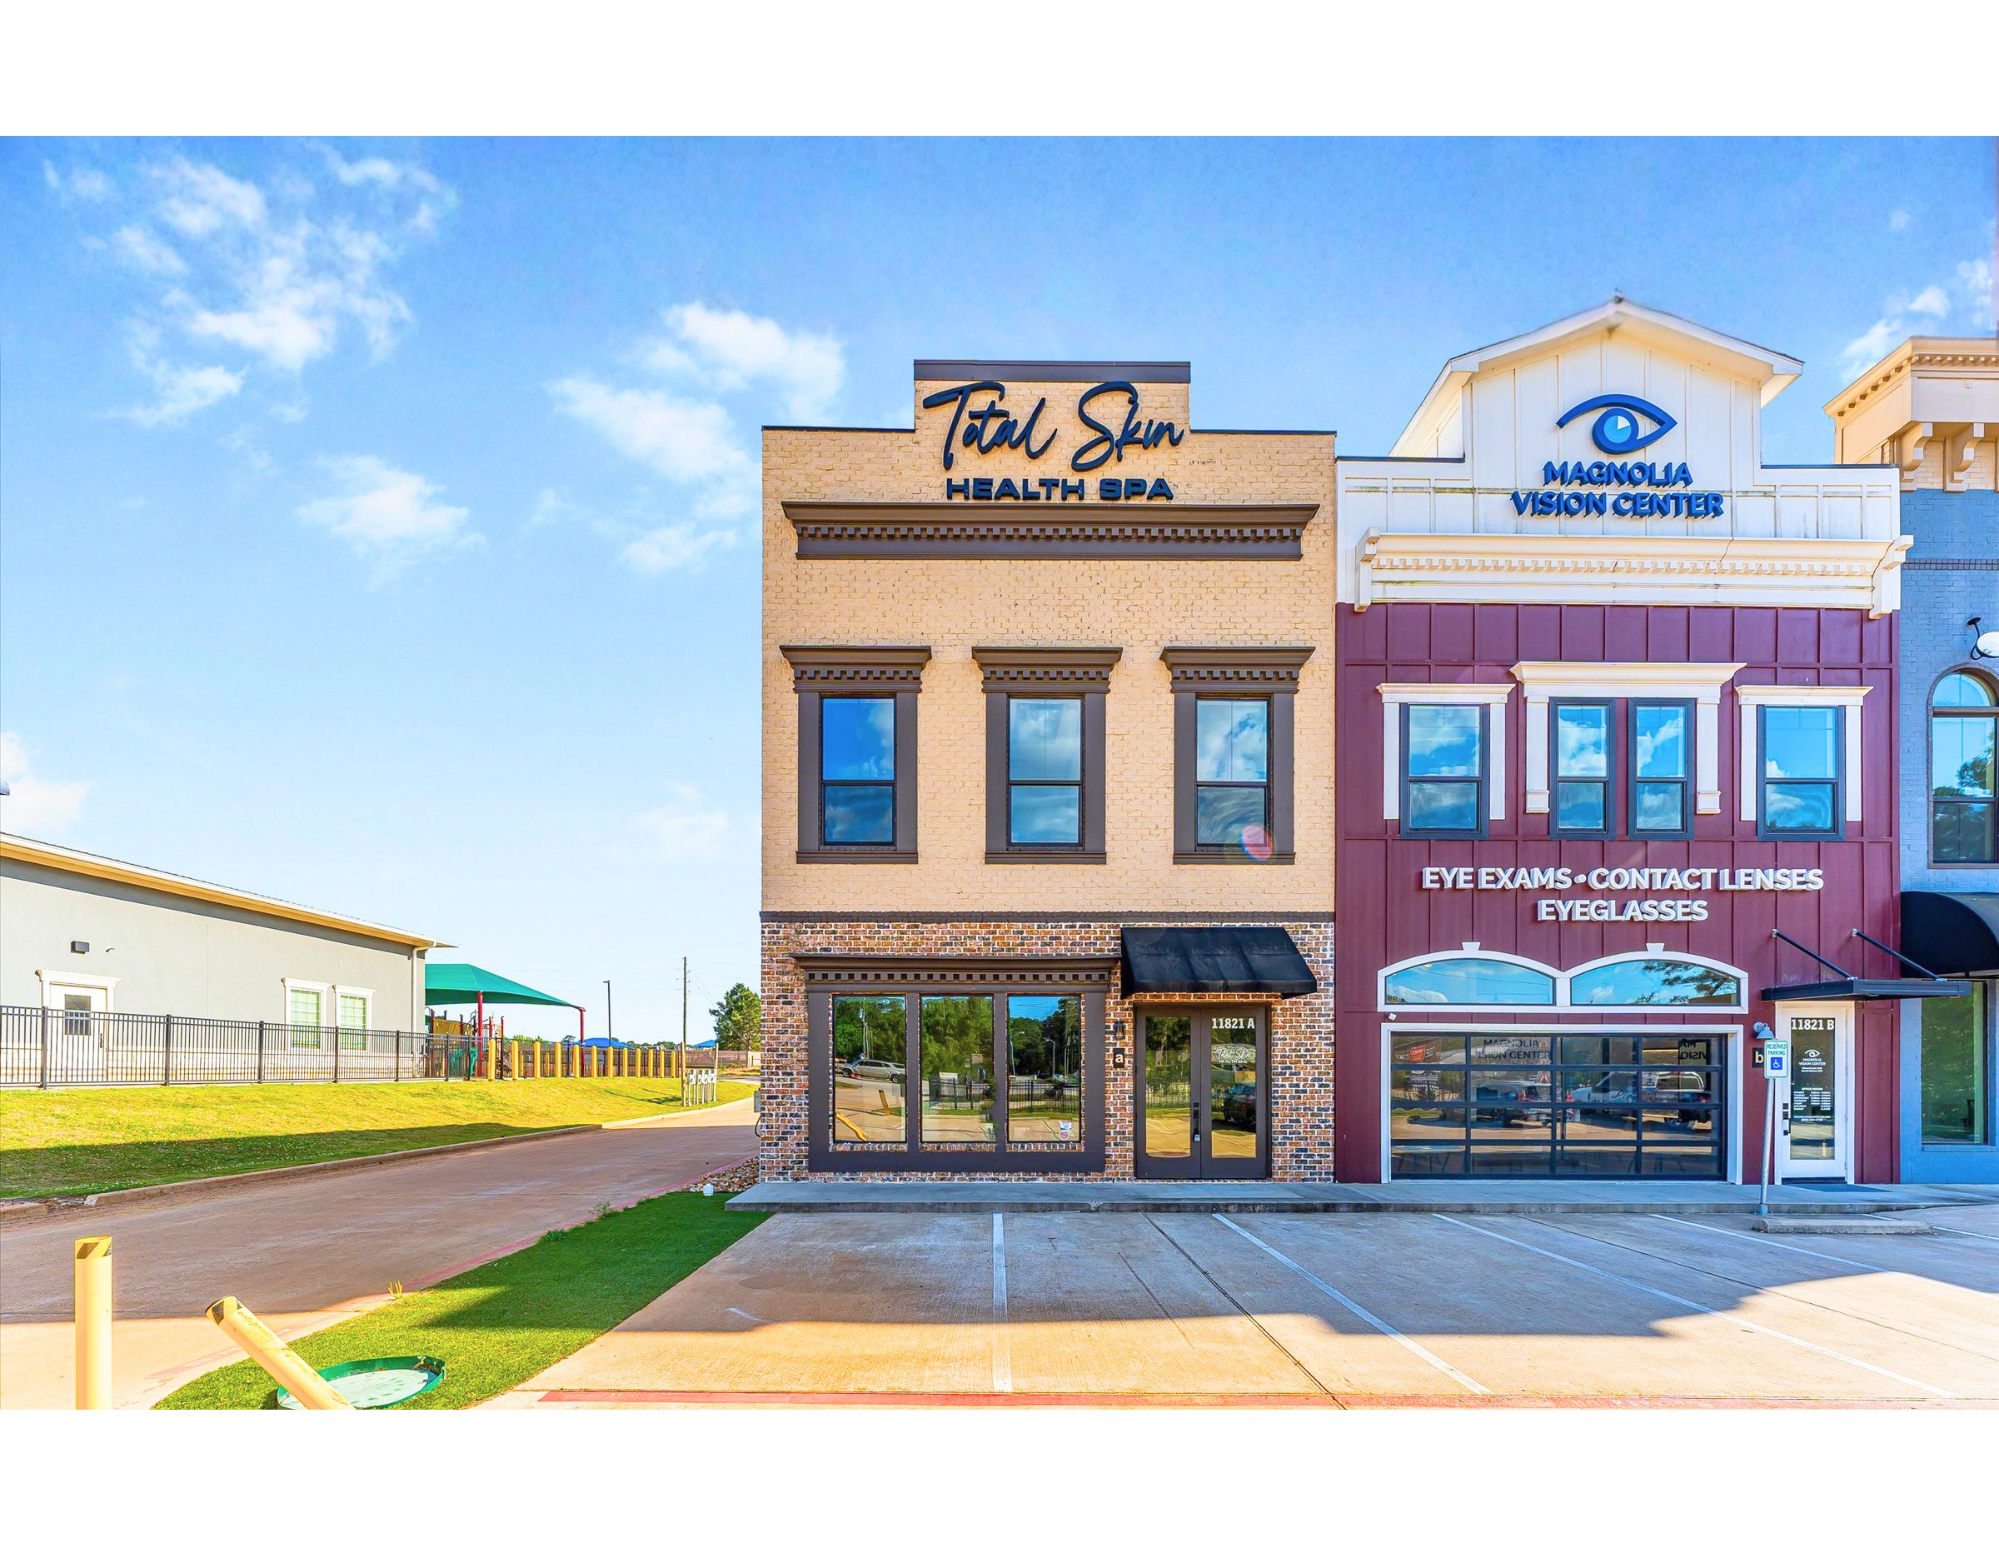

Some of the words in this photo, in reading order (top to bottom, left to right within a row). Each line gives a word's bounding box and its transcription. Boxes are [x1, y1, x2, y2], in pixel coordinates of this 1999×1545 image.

[923, 381, 1057, 470] Total
[1071, 381, 1184, 472] Skin
[1543, 461, 1693, 487] MAGNOLIA
[946, 478, 1084, 500] HEALTH
[1099, 478, 1174, 500] SPA
[1511, 491, 1607, 517] VISION
[1612, 492, 1724, 518] CENTER
[1422, 867, 1474, 890] EYE
[1478, 867, 1572, 890] EXAMS
[1588, 868, 1717, 890] CONTACT
[1719, 868, 1824, 891] LENSES
[1537, 900, 1708, 922] EYEGLASSES
[1212, 1017, 1244, 1029] 11821
[1247, 1017, 1255, 1029] A
[1791, 1019, 1824, 1030] 11821
[1827, 1019, 1834, 1030] B
[1115, 1053, 1124, 1063] a
[1755, 1051, 1764, 1063] b
